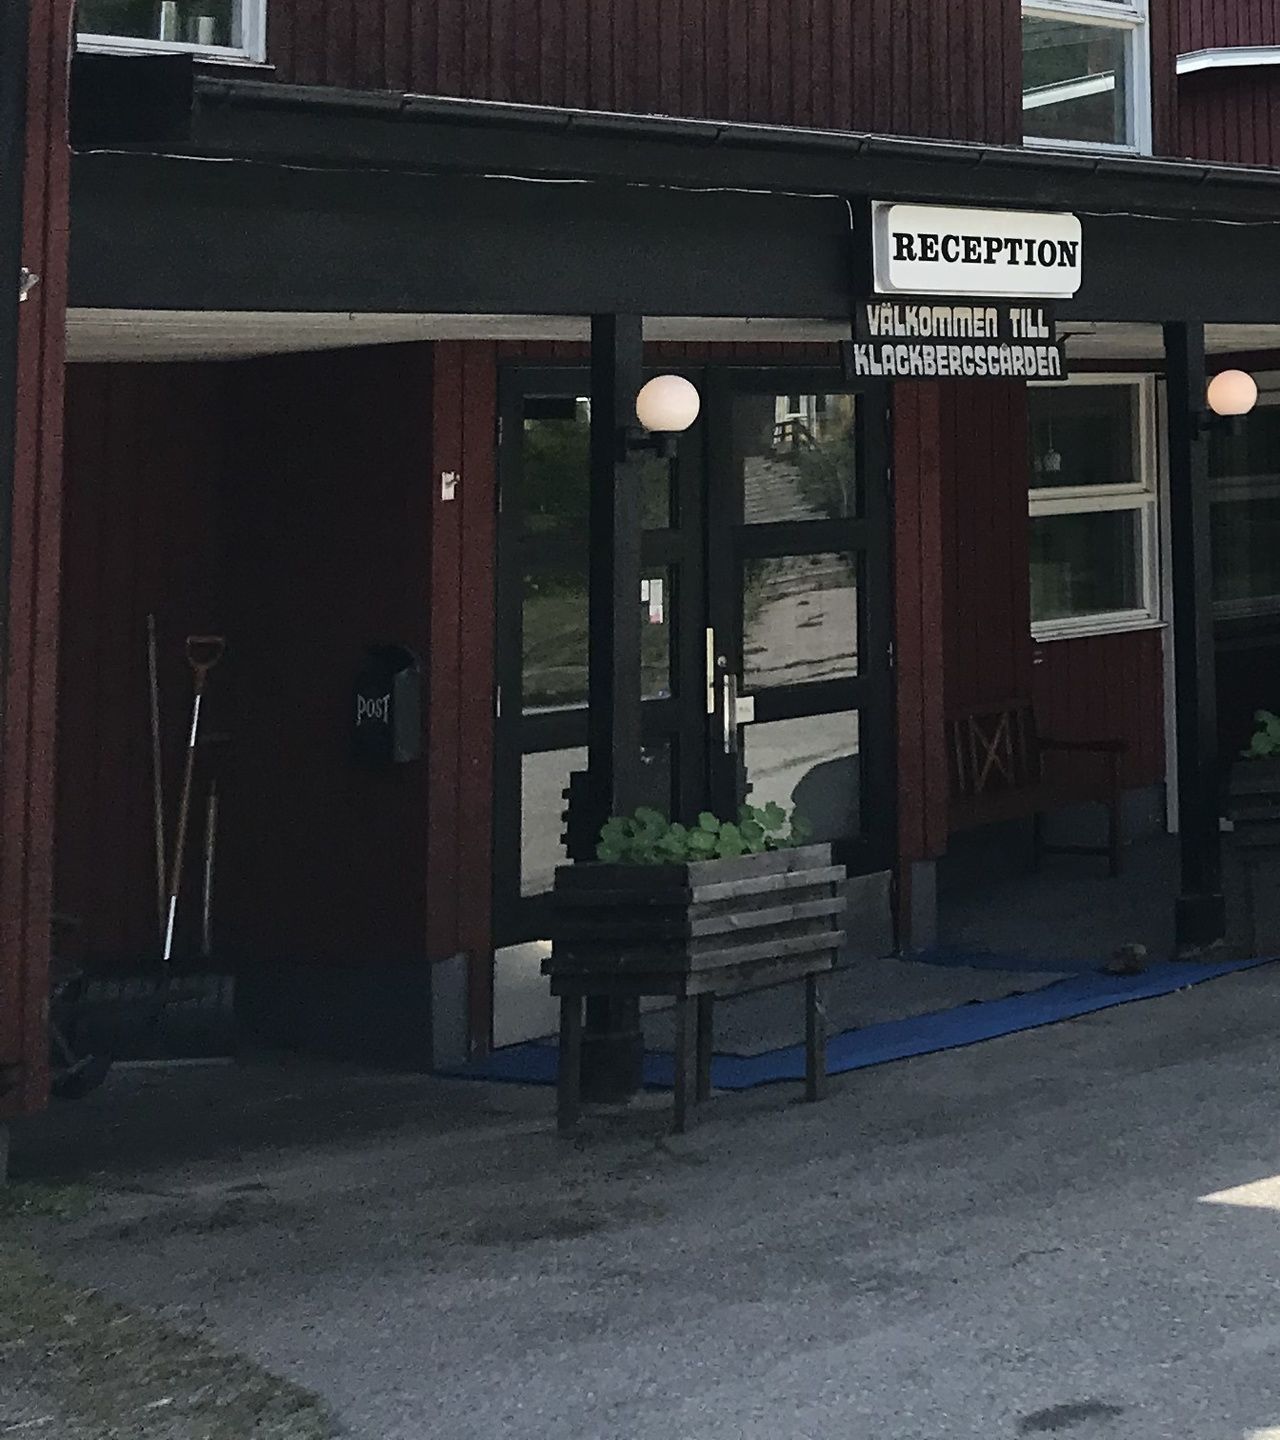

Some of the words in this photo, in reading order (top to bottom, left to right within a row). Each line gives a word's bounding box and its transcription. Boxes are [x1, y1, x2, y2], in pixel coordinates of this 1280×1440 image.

[893, 232, 1079, 268] RECEPTION
[867, 302, 998, 338] VÄLKOMMEN
[1010, 308, 1049, 338] TILL
[854, 343, 1061, 376] KLACKBERGSGÅRDEN
[356, 694, 390, 726] POST
